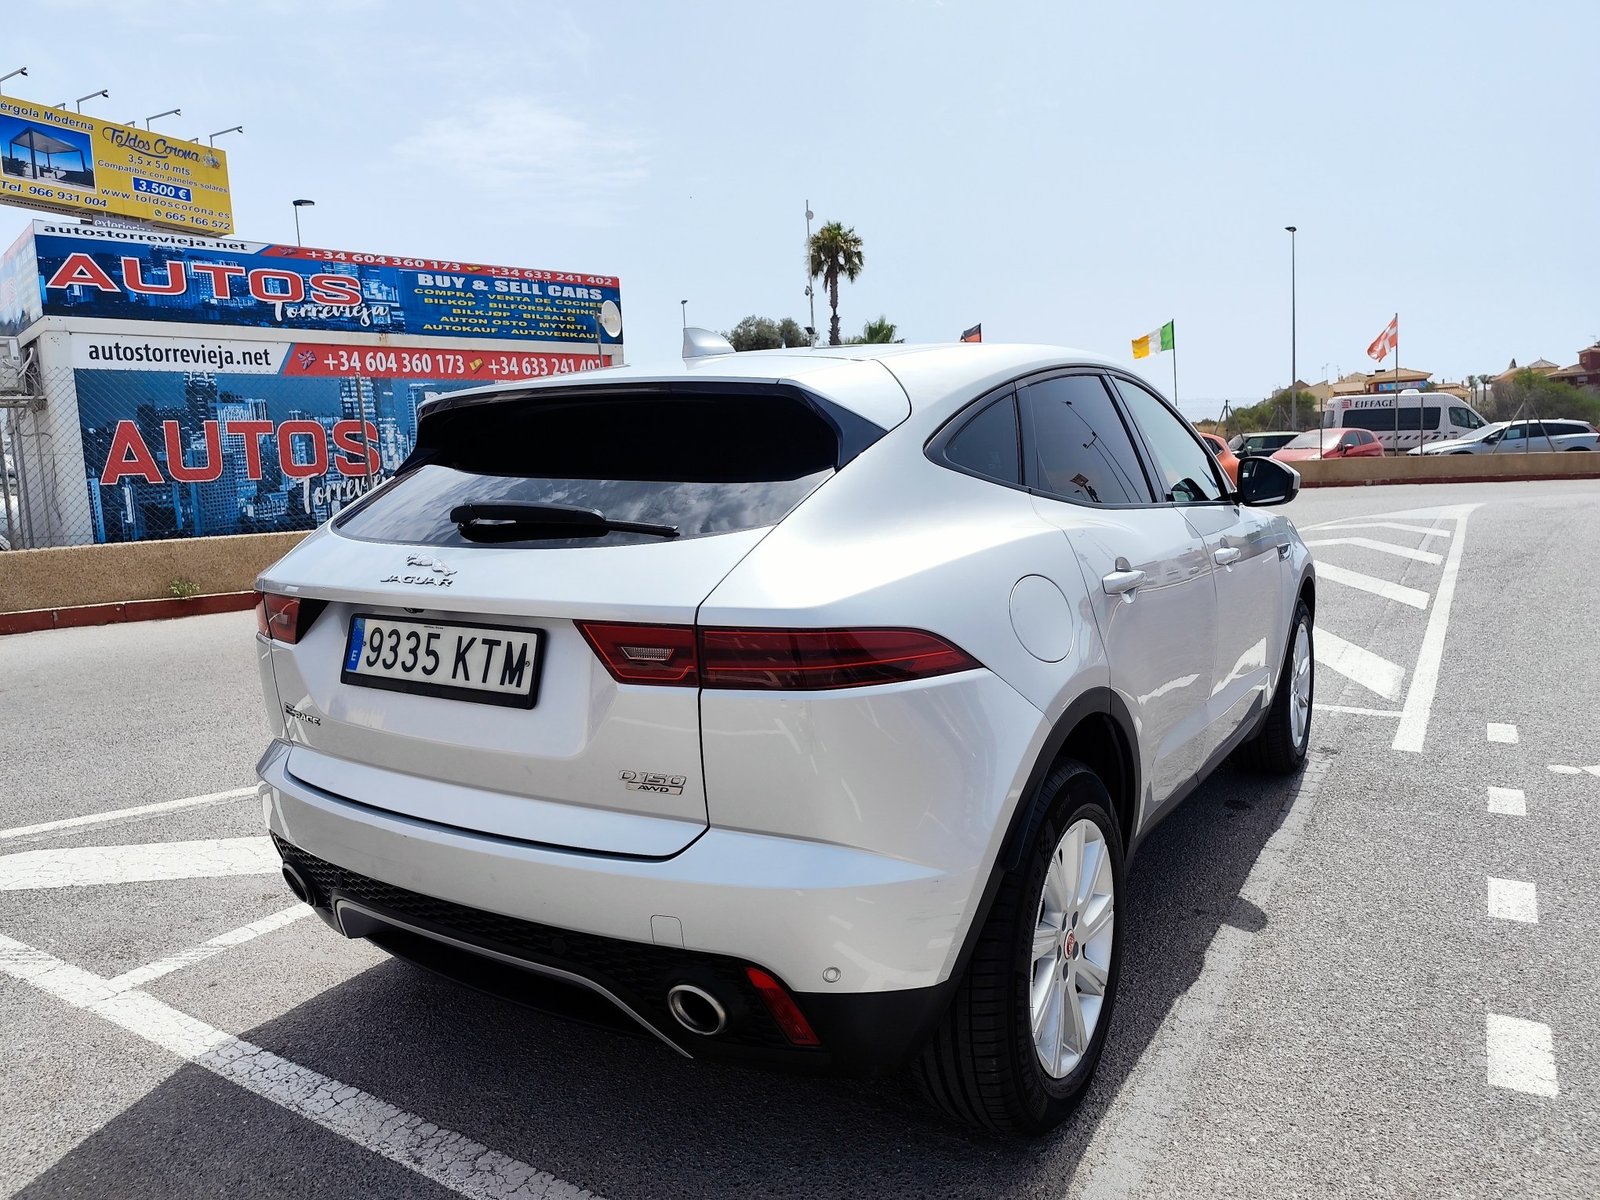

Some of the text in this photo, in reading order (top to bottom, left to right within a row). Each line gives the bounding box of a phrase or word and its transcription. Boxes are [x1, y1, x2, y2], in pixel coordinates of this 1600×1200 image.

[0, 101, 94, 130] érgola Moderna
[102, 127, 200, 162] Toldos Corona
[98, 159, 228, 194] Compatible con paneles solares
[172, 164, 193, 176] mts.
[1, 180, 108, 208] Tel. 966 931 004
[138, 180, 188, 200] 3.500 €
[165, 211, 231, 231] 665 166 572
[43, 224, 248, 251] autostorrevieja.net
[306, 250, 461, 272] +34 604 360 173
[46, 252, 363, 306] AUTOS
[417, 273, 603, 300] BUY & SELL CARS
[487, 267, 613, 286] +34 633 241 402
[413, 288, 475, 298] COMPRA
[486, 294, 531, 303] VENTA
[555, 300, 603, 308] COCHES
[424, 297, 476, 306] BILKÖP
[270, 301, 389, 327] Torrevieja
[440, 316, 488, 325] AUTON
[492, 319, 528, 327] OSTO
[539, 322, 587, 331] MYYNTI
[452, 308, 511, 317] BILKJØP
[522, 313, 576, 322] BILSALG
[423, 323, 499, 333] AUTOKAUF
[88, 344, 272, 369] autostorrevieja.net
[323, 350, 465, 374] +34 604 360 173
[488, 355, 519, 375] +34
[522, 357, 548, 376] 633
[551, 358, 576, 377] 241
[1354, 399, 1394, 408] EIFFAGE
[100, 420, 381, 485] AUTOS
[380, 575, 454, 587] JAGUAR
[350, 650, 358, 661] E
[366, 626, 528, 688] 9335 KTM
[619, 769, 687, 786] D150
[637, 784, 669, 793] AWD
